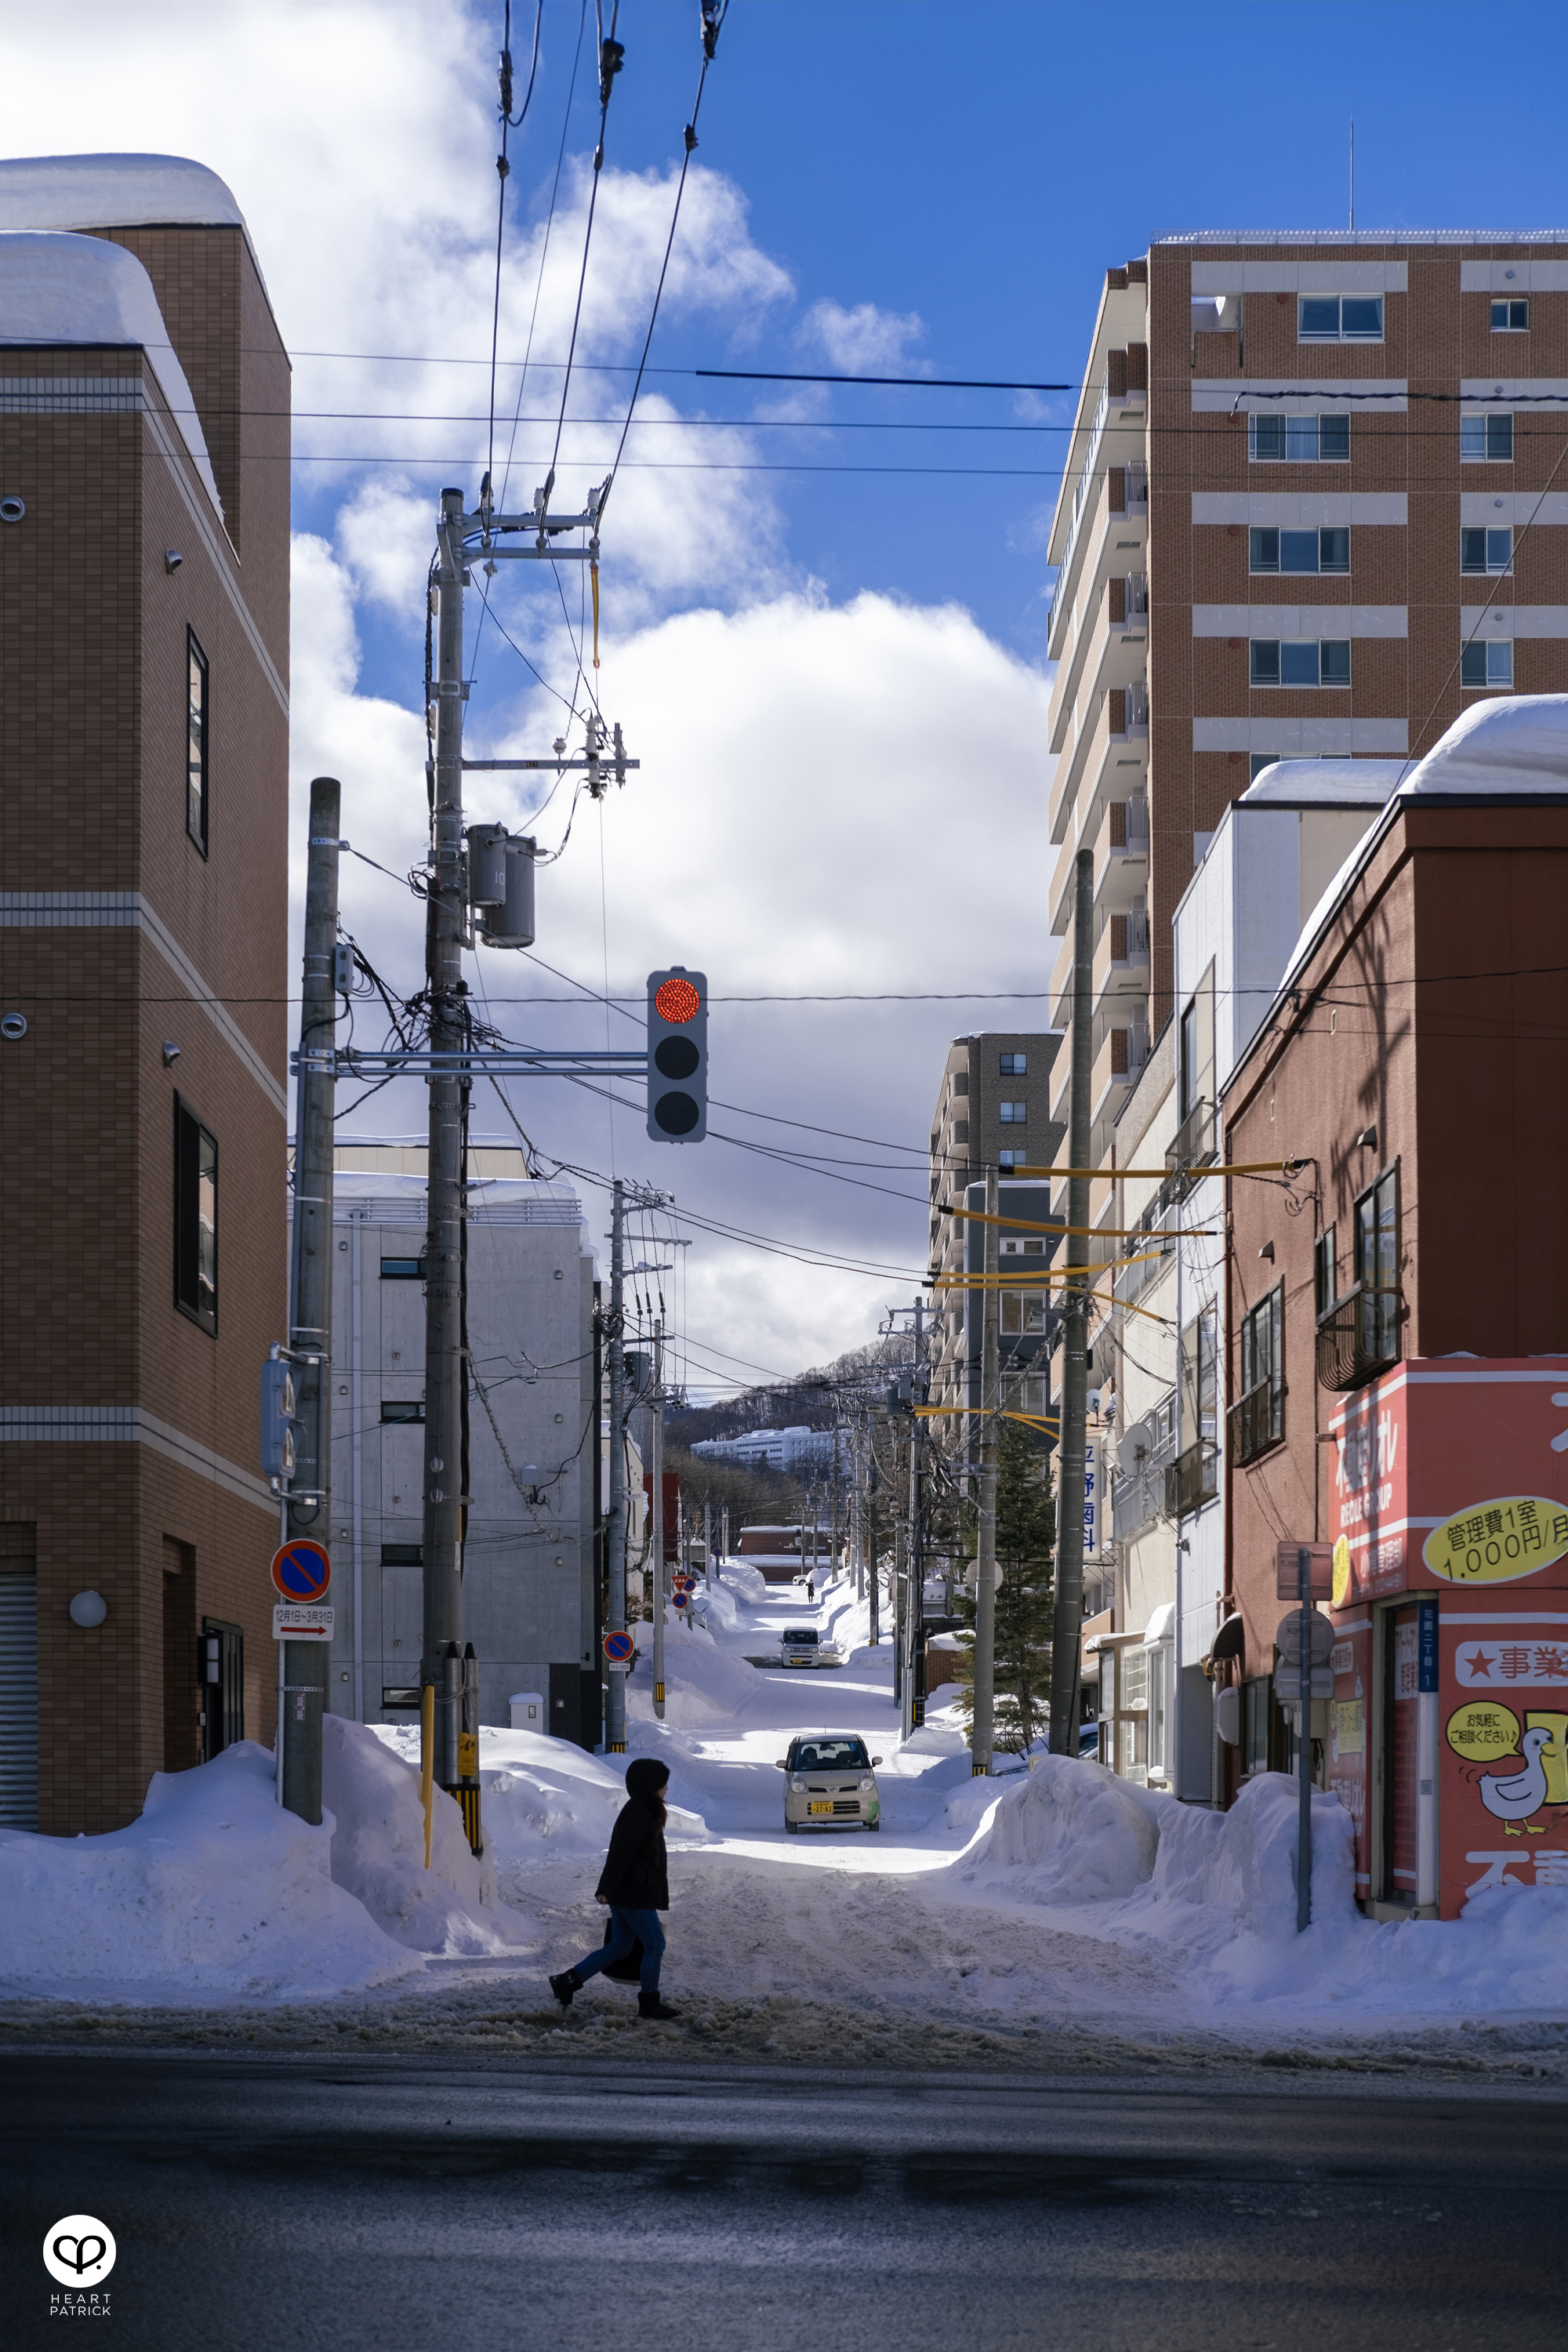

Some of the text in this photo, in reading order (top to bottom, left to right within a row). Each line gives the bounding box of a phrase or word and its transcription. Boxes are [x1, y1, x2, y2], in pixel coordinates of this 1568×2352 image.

[495, 870, 505, 885] 10
[1340, 1483, 1392, 1529] REOLE GROUP
[1447, 1500, 1538, 1551] 管理費1室
[1467, 1713, 1501, 1727] お気軽に
